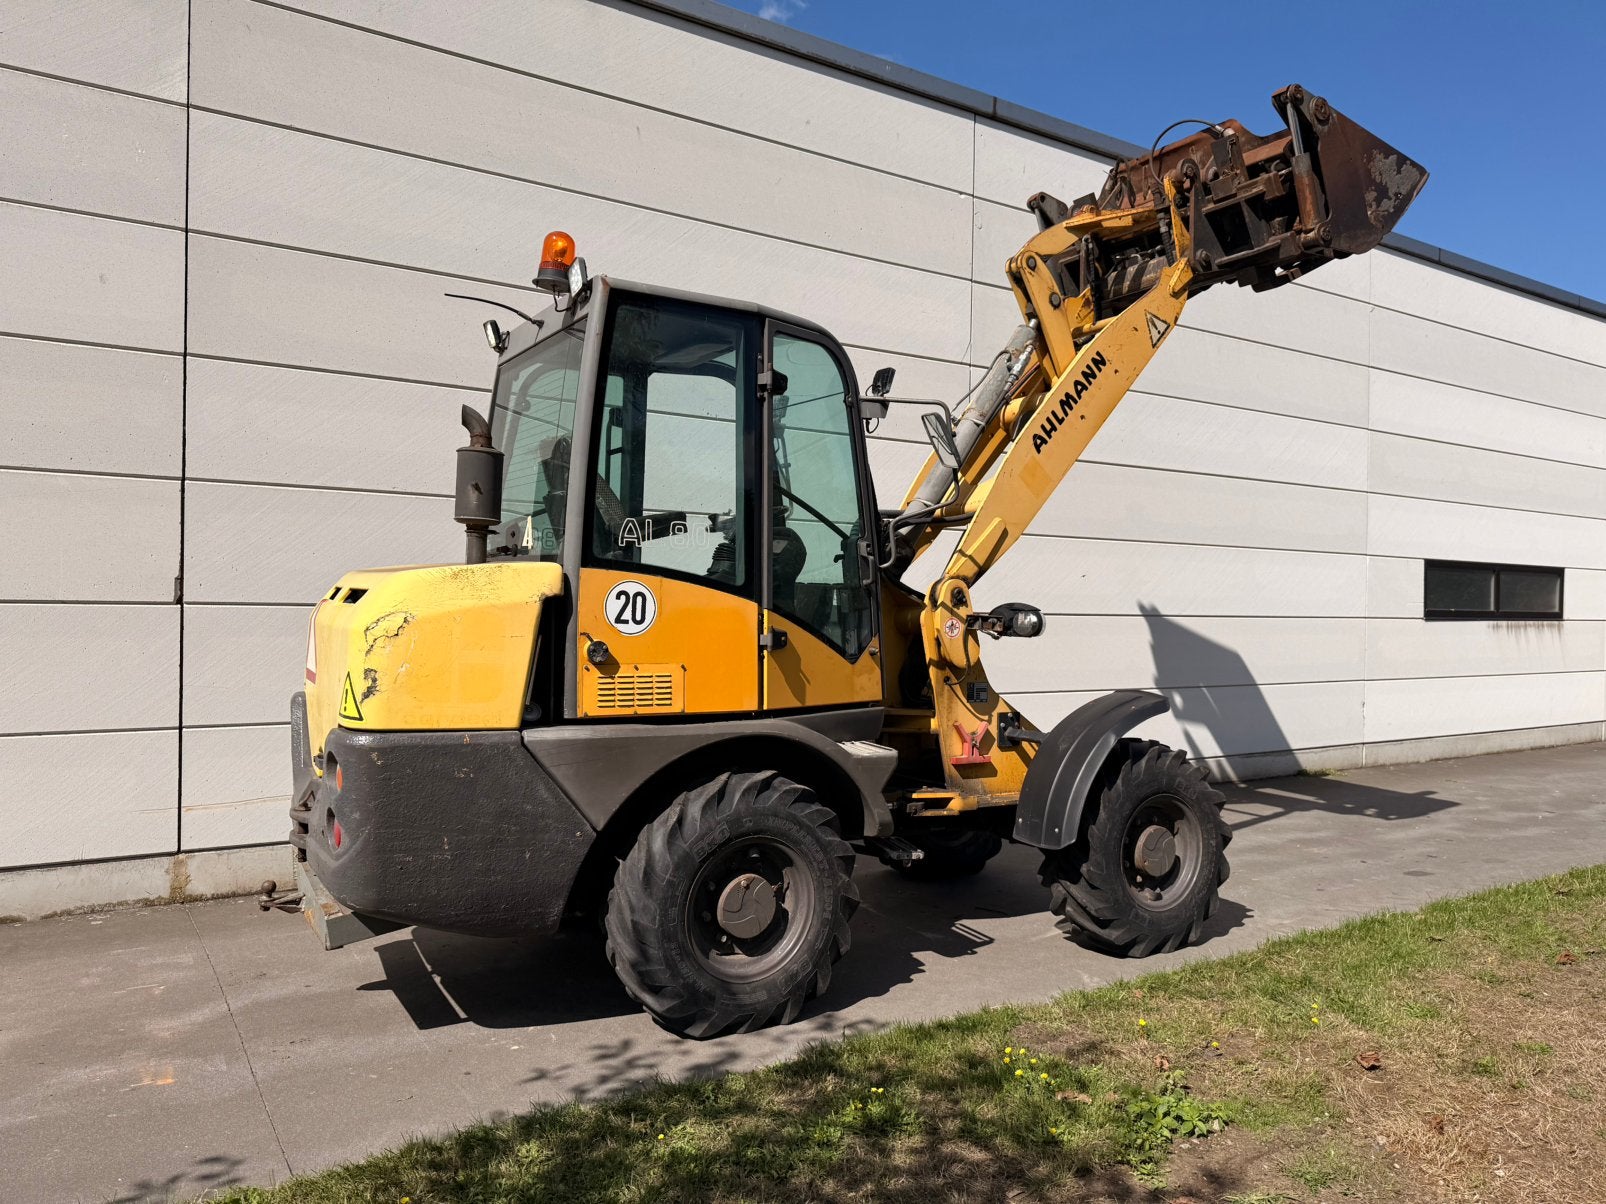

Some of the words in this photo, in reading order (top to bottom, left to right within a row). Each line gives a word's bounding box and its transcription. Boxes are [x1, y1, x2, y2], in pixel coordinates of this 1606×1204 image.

[1032, 350, 1107, 455] AHLMANN
[618, 517, 656, 548] AL
[669, 520, 711, 549] 80
[614, 589, 647, 626] 20
